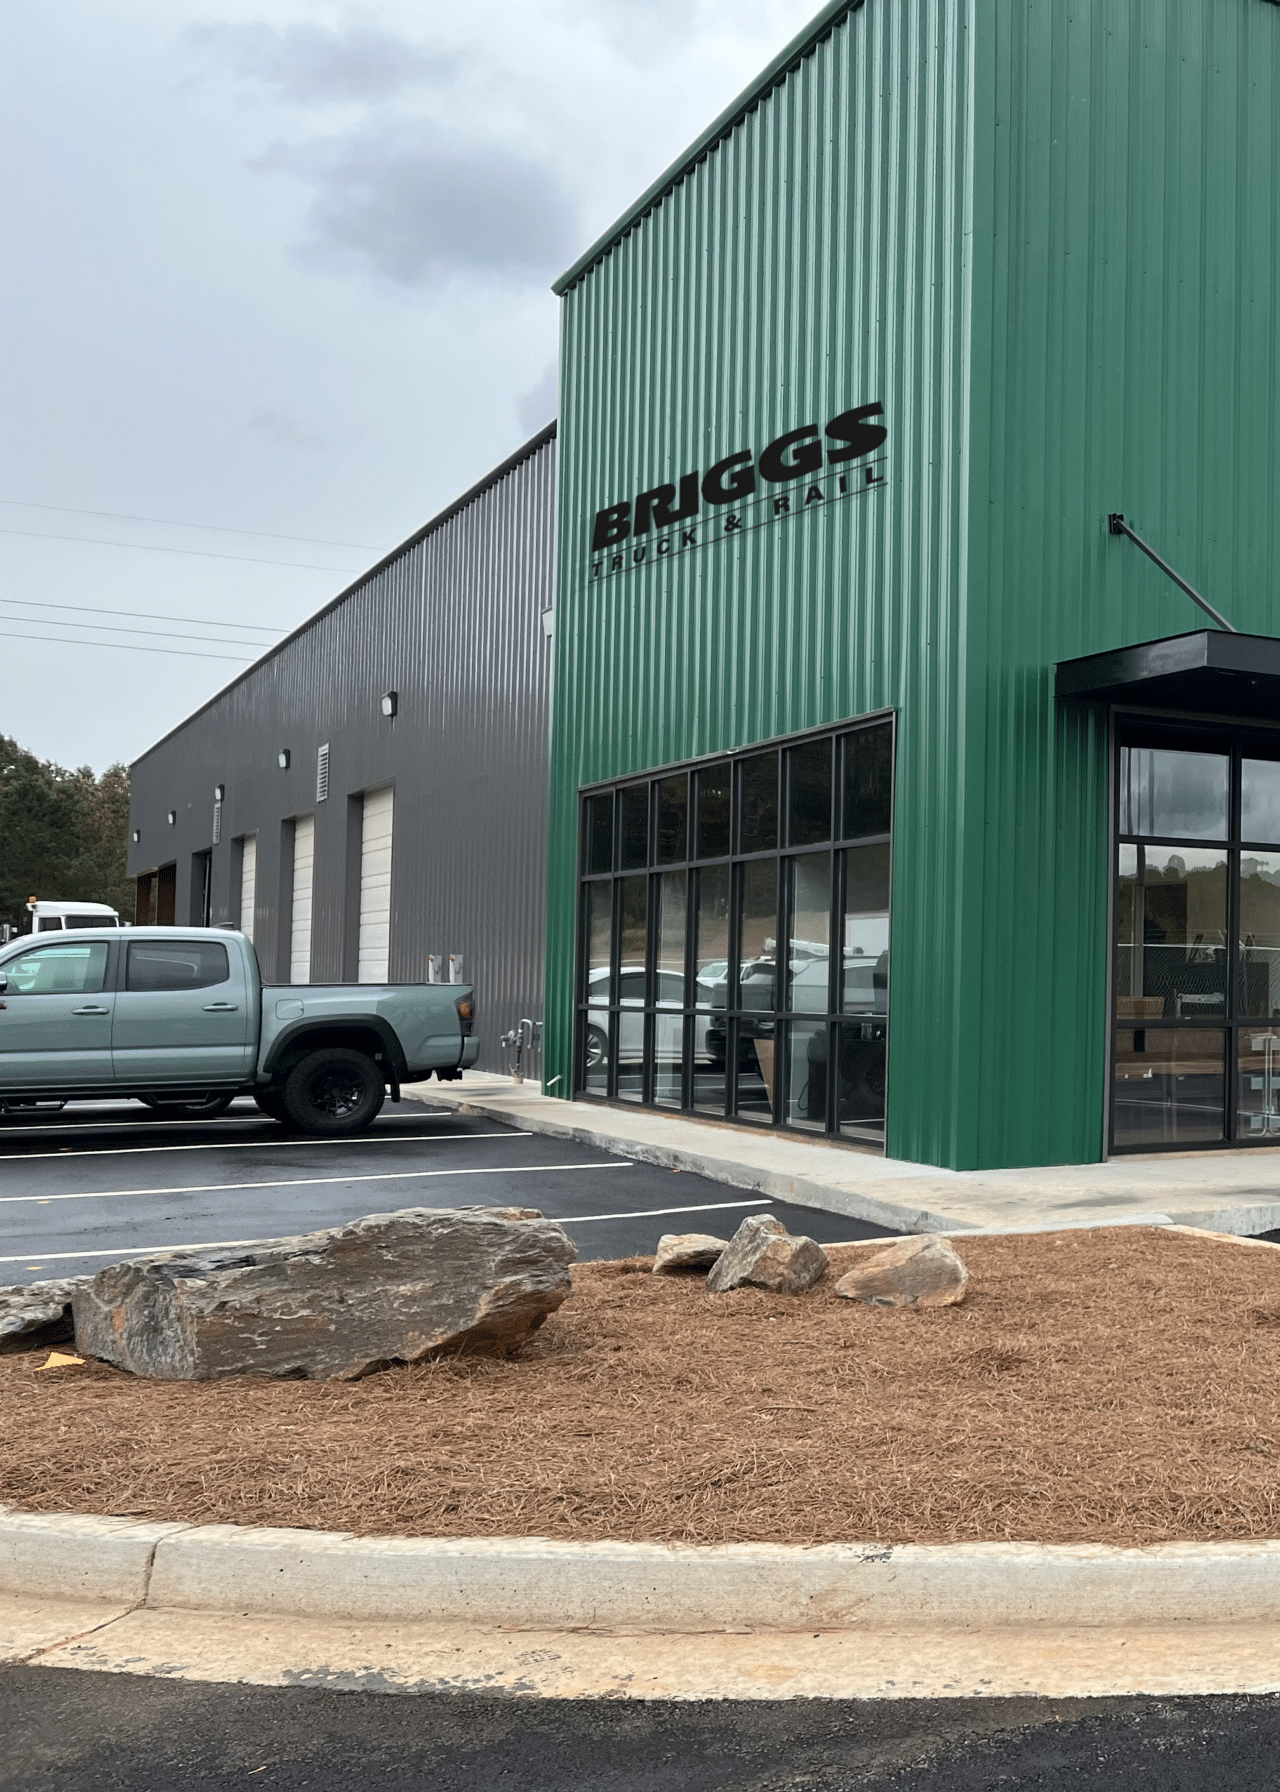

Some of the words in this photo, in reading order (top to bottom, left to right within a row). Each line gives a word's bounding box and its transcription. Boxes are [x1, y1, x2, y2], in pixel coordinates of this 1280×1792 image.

[592, 401, 887, 552] BRIGGS
[592, 528, 697, 577] TRUCK
[724, 514, 743, 533] &
[773, 467, 884, 516] RAIL
